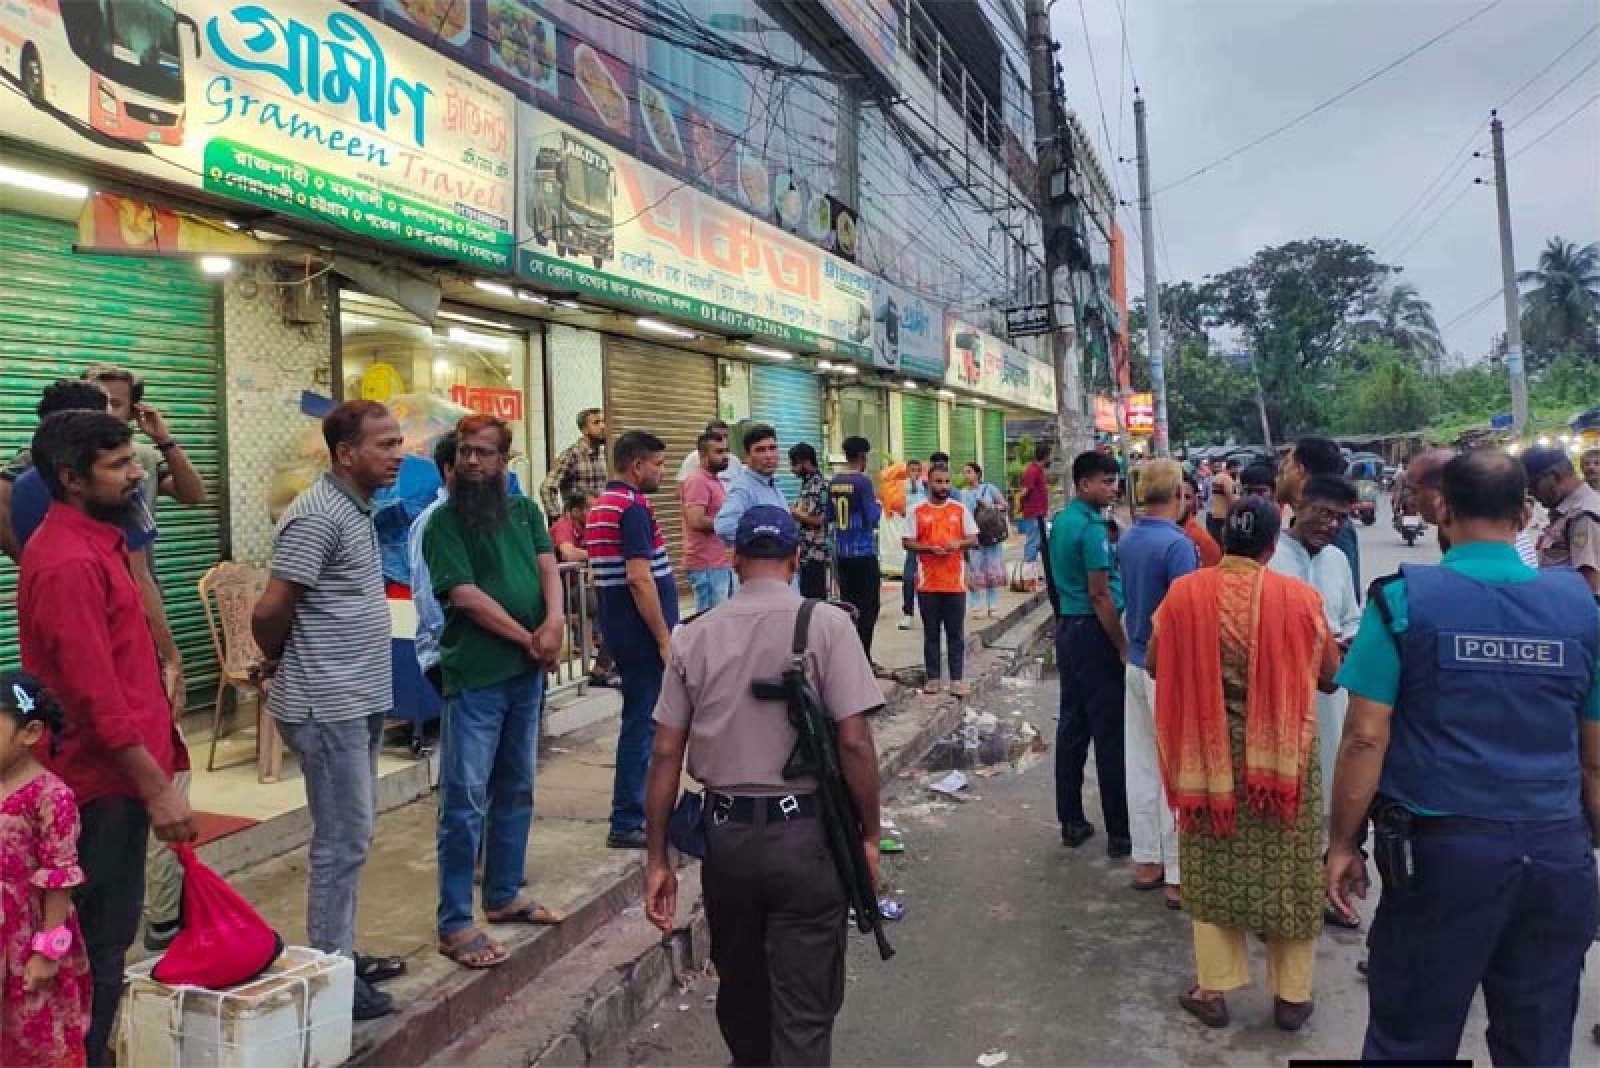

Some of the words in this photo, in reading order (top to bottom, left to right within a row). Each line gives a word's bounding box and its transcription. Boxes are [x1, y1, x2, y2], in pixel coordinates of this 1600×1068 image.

[205, 5, 434, 148] গ্রামীণ
[205, 76, 391, 167] Grameen
[618, 158, 822, 303] একতা
[1464, 641, 1553, 661] POLICE
